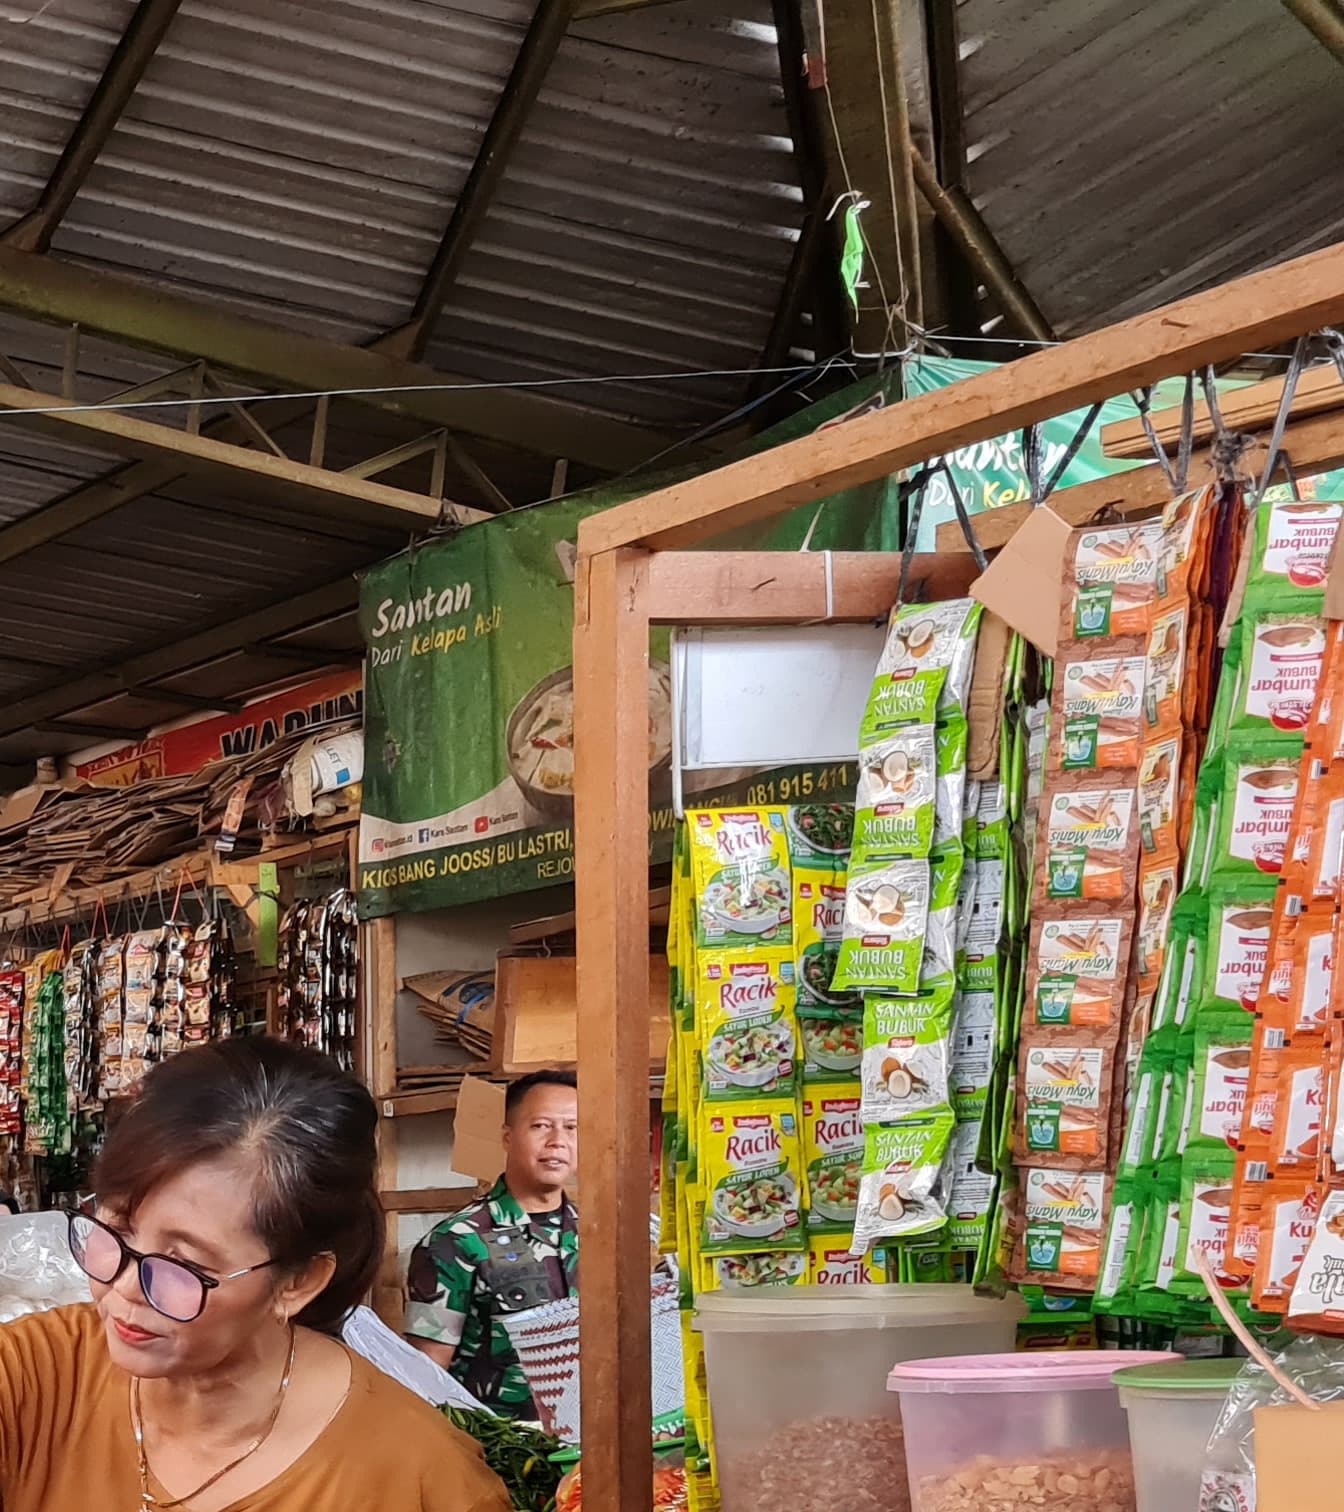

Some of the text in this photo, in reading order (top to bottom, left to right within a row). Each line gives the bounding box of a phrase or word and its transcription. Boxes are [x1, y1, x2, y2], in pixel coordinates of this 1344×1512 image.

[982, 482, 1030, 508] Kel
[372, 582, 472, 638] Santan
[372, 606, 503, 668] Dari Kelapa Asli
[1276, 666, 1318, 678] BUBUK
[874, 696, 926, 717] SANTAN
[221, 690, 364, 758] WARUN
[747, 784, 775, 807] 081
[779, 772, 813, 800] 915
[817, 764, 848, 791] 411
[863, 815, 917, 833] BUBUK
[1050, 827, 1124, 843] Kayu Manis
[362, 867, 398, 889] KIOS
[398, 859, 436, 884] BANG
[497, 842, 515, 864] BU
[813, 903, 846, 929] Raci
[849, 949, 904, 965] BUBUK
[1081, 957, 1114, 973] Kayu
[845, 966, 907, 980] SANTAN
[719, 976, 778, 1009] Racik
[876, 1019, 926, 1036] BUBUK
[1026, 1082, 1097, 1100] Kayu Manis
[725, 1127, 783, 1161] Racik
[1026, 1203, 1099, 1222] Kayu Manis
